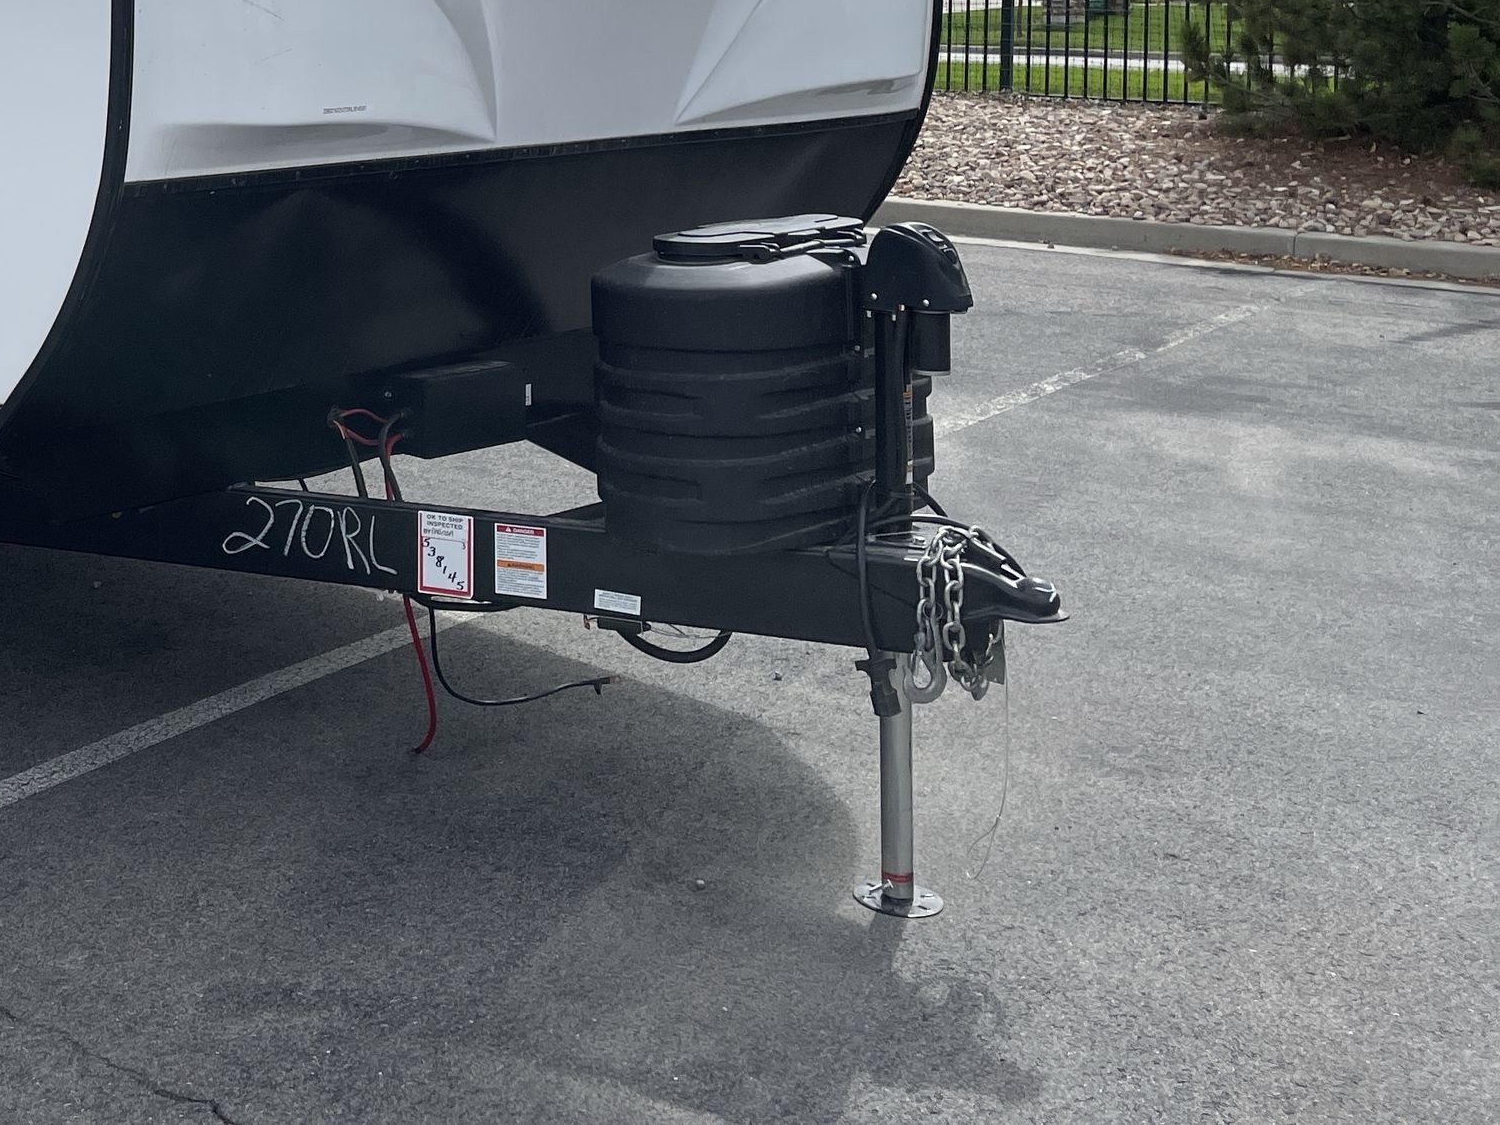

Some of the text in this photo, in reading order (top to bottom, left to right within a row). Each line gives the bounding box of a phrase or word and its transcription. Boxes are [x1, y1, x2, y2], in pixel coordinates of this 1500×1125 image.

[426, 520, 464, 530] INSPECTED
[448, 516, 464, 524] SHIP
[222, 496, 398, 575] 270RL
